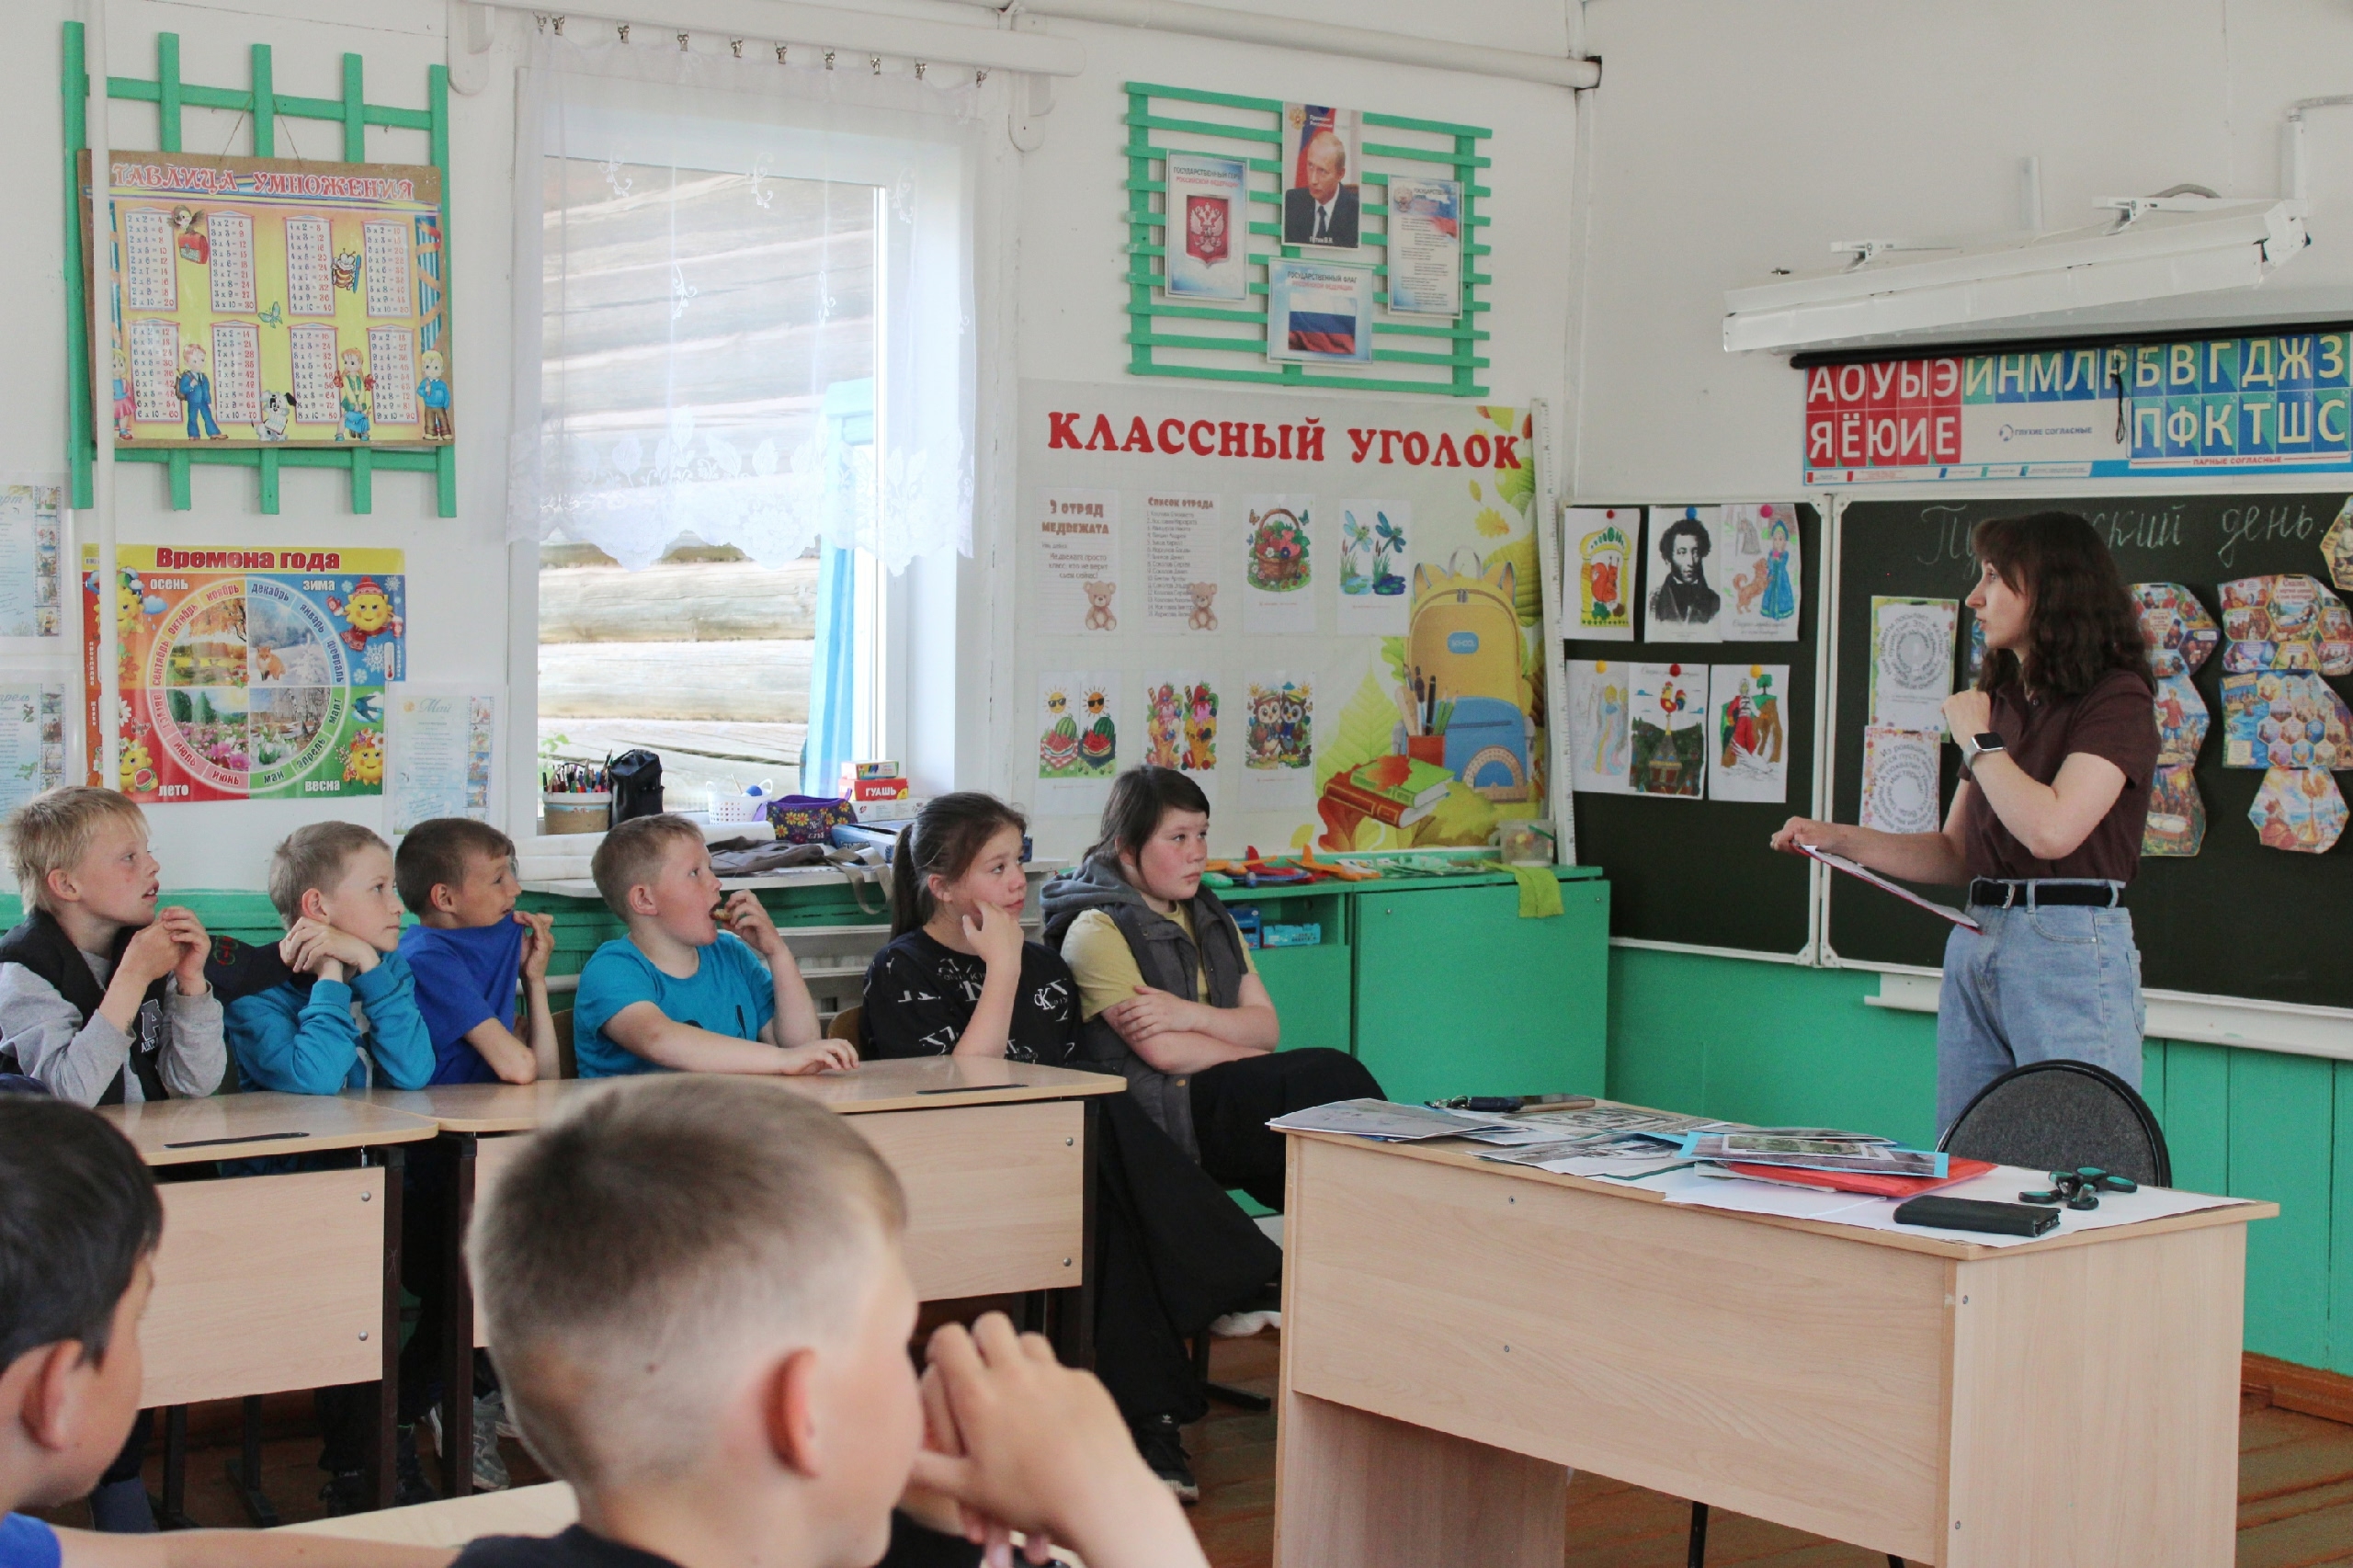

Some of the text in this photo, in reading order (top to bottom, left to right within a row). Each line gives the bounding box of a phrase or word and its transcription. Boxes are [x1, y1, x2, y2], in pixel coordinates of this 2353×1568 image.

[112, 164, 415, 199] ТАБЛИЦА УМНОЖЕНИЯ
[1048, 412, 1522, 470] КЛАССНЫЙ УГОЛОК
[2015, 428, 2042, 437] ГЛУХИЕ
[2231, 456, 2281, 464] СОГЛАСНЫЕ
[156, 547, 340, 572] Времена года
[150, 579, 189, 590] осень
[206, 584, 240, 602] ноябрь
[251, 583, 290, 602] декабрь
[302, 580, 335, 591] зима
[167, 604, 199, 635] октябрь
[300, 604, 324, 633] январь
[153, 640, 169, 687] сентябрь
[326, 640, 345, 683] февраль
[153, 694, 172, 729] август
[328, 698, 343, 724] март
[174, 742, 196, 767] июль
[296, 738, 326, 769] апрель
[211, 770, 240, 785] июнь
[304, 779, 340, 792] весна
[158, 784, 189, 797] лето
[865, 786, 897, 797] ГУАШЬ
